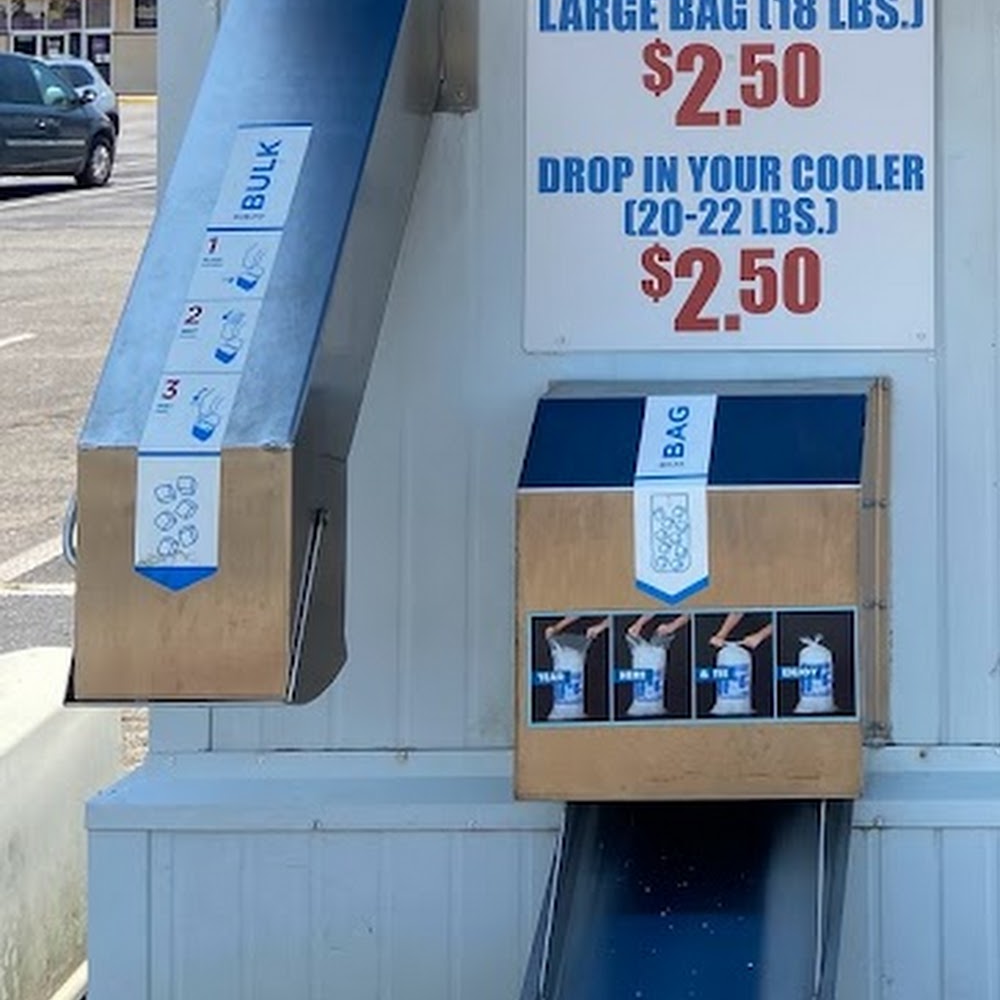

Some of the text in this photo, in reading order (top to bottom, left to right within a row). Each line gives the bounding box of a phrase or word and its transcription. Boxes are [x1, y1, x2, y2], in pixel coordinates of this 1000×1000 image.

[642, 38, 822, 127] $2.50
[240, 139, 282, 210] BULK
[538, 154, 925, 193] DROP IN YOUR COOLER
[624, 198, 838, 237] (20-22 LBS.)
[208, 236, 219, 255] 1
[640, 243, 822, 332] $2.50
[184, 305, 203, 325] 2
[161, 378, 181, 400] 3
[662, 405, 690, 458] BAG
